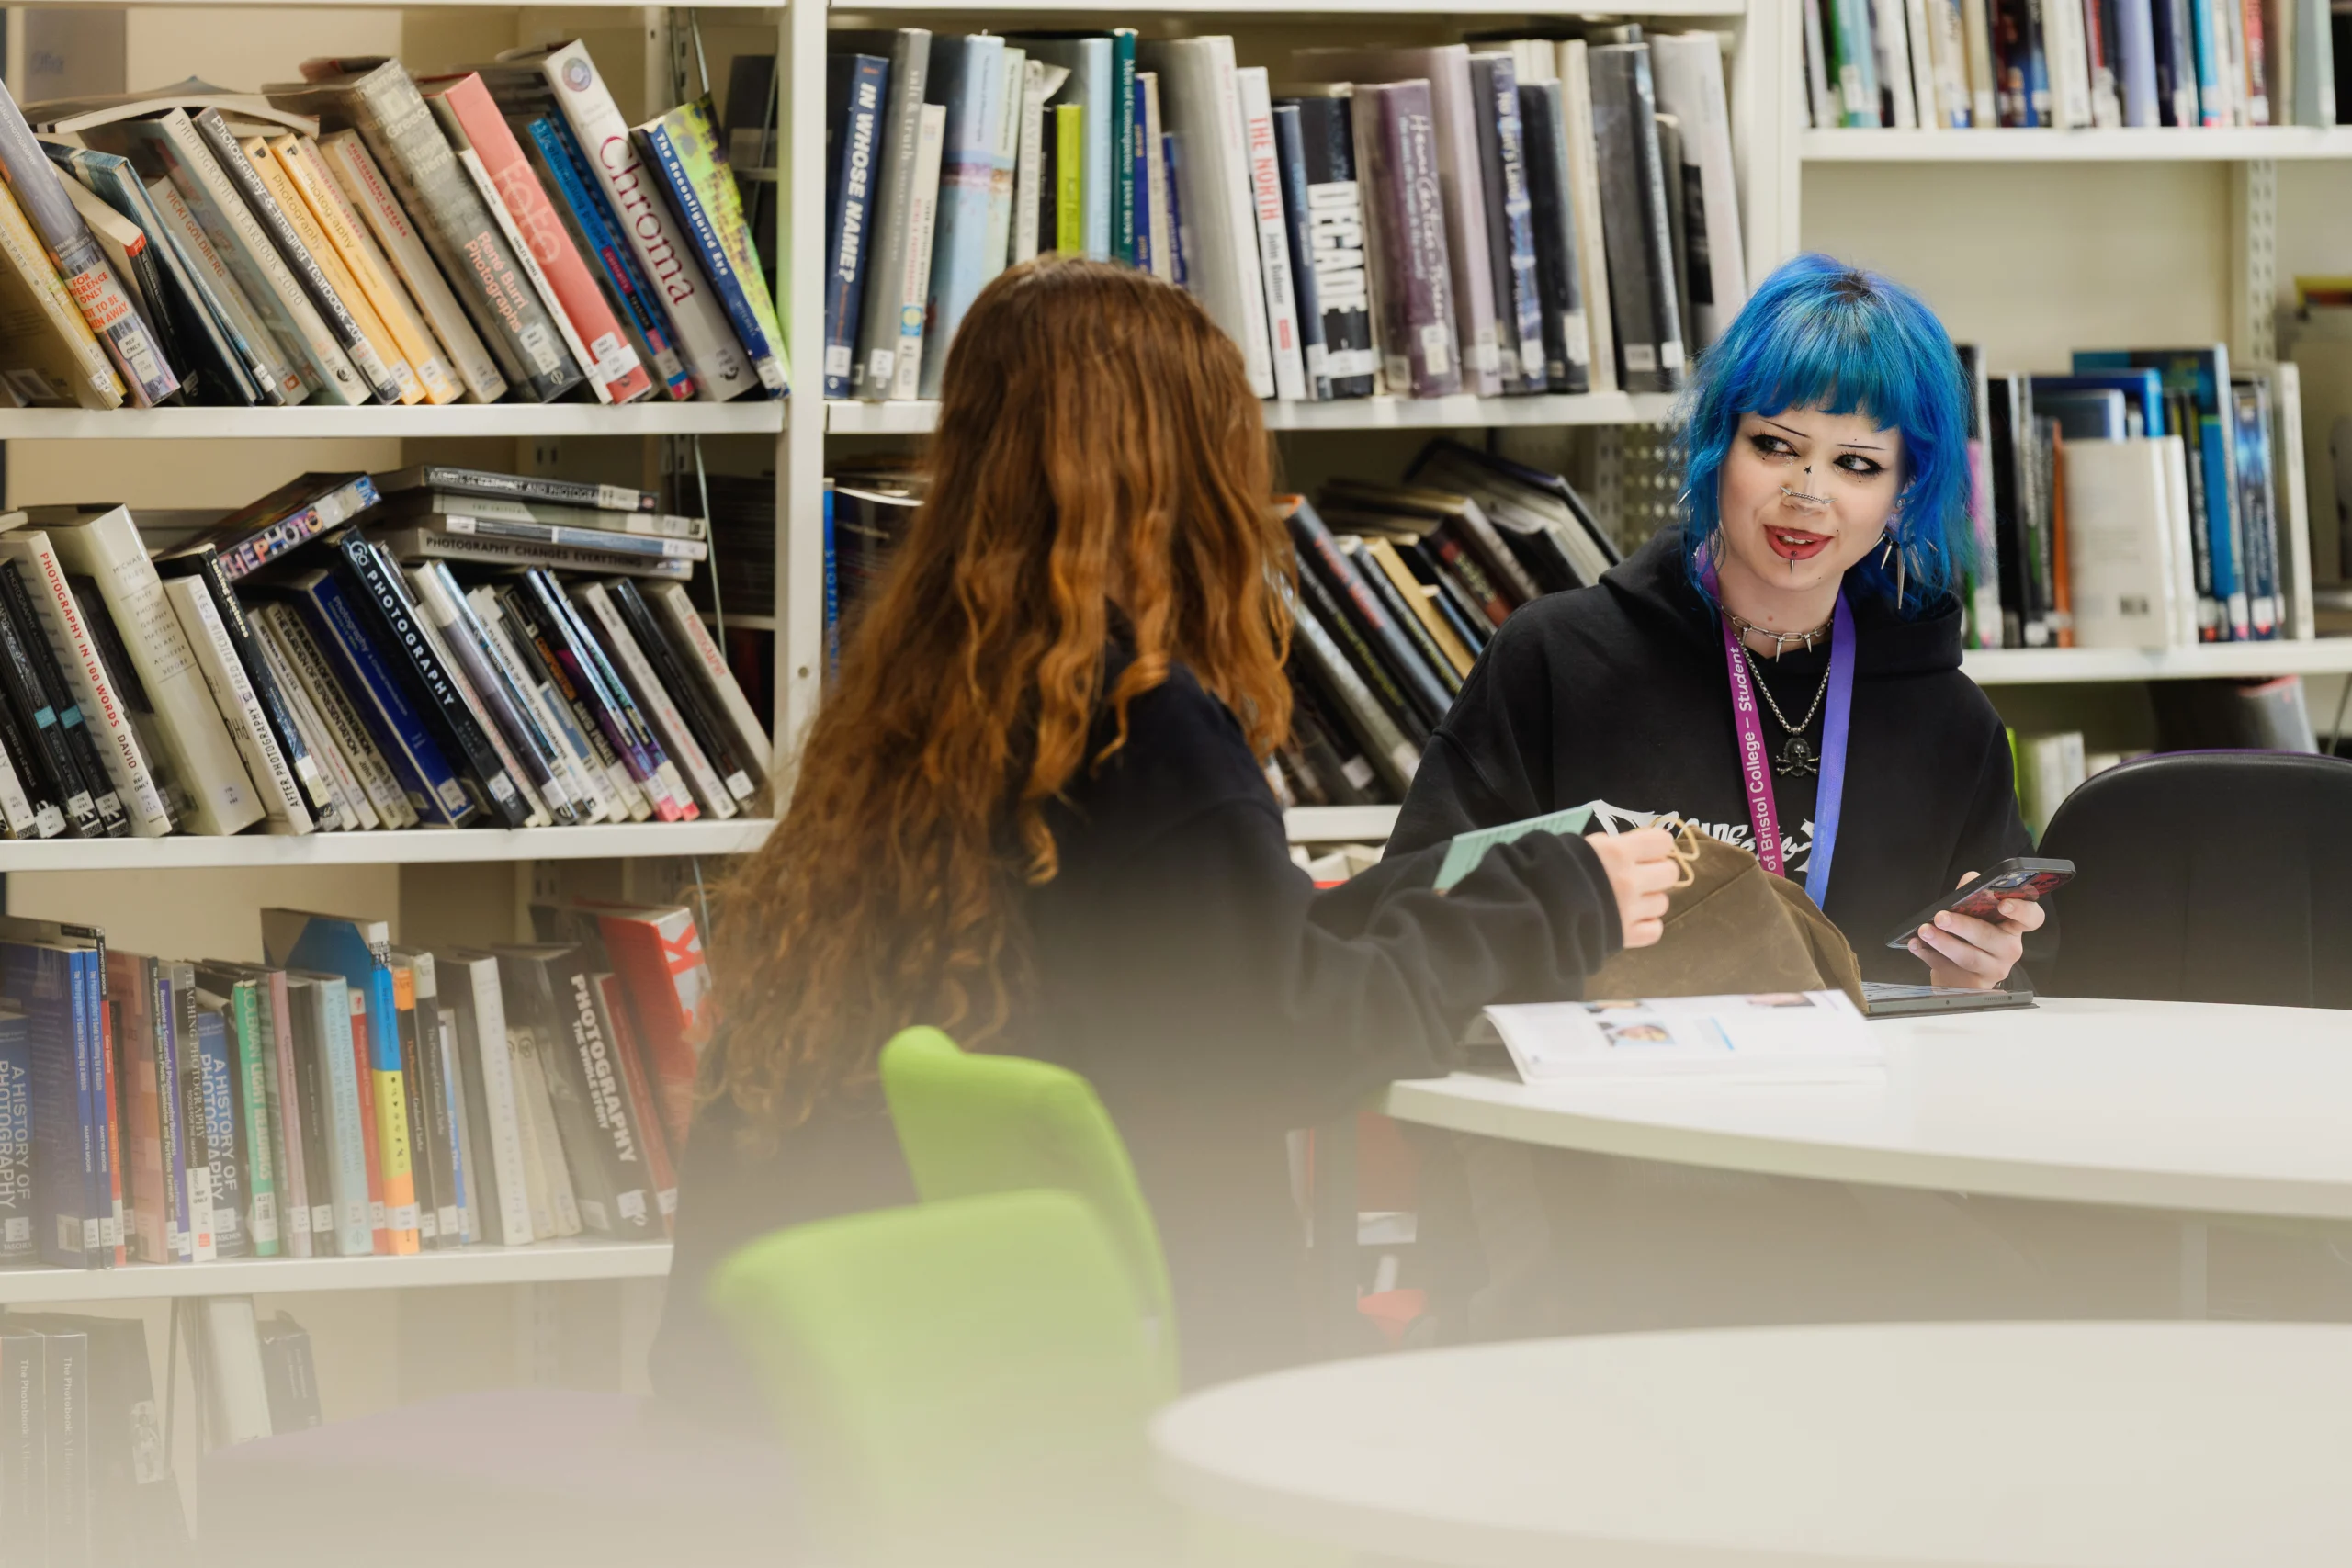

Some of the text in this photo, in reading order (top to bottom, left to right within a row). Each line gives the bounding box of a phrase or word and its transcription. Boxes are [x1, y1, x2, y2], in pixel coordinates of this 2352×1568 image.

[906, 101, 919, 113] &
[1023, 102, 1040, 164] DAVID
[1247, 114, 1271, 152] THE
[5, 118, 38, 166] PHOTOGRAPHY
[207, 114, 268, 197] Photography
[899, 118, 918, 160] truth
[263, 195, 277, 209] &
[303, 147, 342, 205] PHOTOGRAPHY
[346, 142, 388, 202] PHOTOGRAPHY
[384, 204, 408, 237] SPEAKS
[836, 82, 876, 283] IN WHOSE NAME?
[1251, 156, 1283, 221] NORTH
[175, 118, 237, 207] PHOTOGRAPHY
[234, 208, 280, 271] YEARBOOK
[276, 271, 305, 307] 2000
[269, 173, 325, 252] Photography
[599, 135, 696, 306] Chroma
[654, 132, 730, 276] The Reconfigured Eye
[164, 189, 188, 220] VICKI
[182, 219, 227, 279] GOLDBERG
[268, 208, 312, 264] Imaging
[1265, 231, 1283, 262] John
[1308, 178, 1367, 315] DECADE
[70, 271, 108, 296] FERENCE
[72, 273, 90, 287] FOR
[79, 287, 103, 304] ONLY
[304, 258, 351, 321] Yearbook
[461, 238, 525, 335] Photographs
[475, 230, 506, 273] René
[498, 269, 529, 310] Burri
[90, 301, 129, 329] KEN AWAY
[96, 300, 107, 313] TO
[107, 294, 119, 304] BE
[125, 337, 136, 346] REF
[126, 343, 141, 355] ONLY
[345, 320, 368, 346] 200
[112, 553, 147, 574] MCHAE
[425, 535, 643, 571] PHOTOGRAPHY CHANGES EVERYTHING
[5, 568, 38, 630] PHOTOGRAPHY
[135, 591, 153, 604] WHY
[135, 599, 164, 617] PHOTO-
[141, 611, 168, 629] GRAPHY
[208, 558, 253, 638] talking pictures
[143, 622, 175, 641] MATTERS
[364, 567, 456, 707] PHOTOGRAPHY
[40, 551, 137, 770] PHOTOGRAPHY IN 100 WORDS DAVID
[162, 657, 188, 676] BEFORE
[228, 664, 247, 691] FRED
[272, 609, 361, 756] THE BURDEN OF REPRESENTATION
[284, 609, 300, 629] THE
[294, 626, 323, 667] BURDEN
[322, 678, 374, 755] REPRESENTATION
[1730, 647, 1752, 712] Student
[245, 705, 286, 778] PHOTOGRAPHY
[1745, 731, 1764, 794] College
[133, 775, 144, 785] REF
[134, 783, 150, 792] ONLY
[277, 777, 300, 808] AFTER
[1752, 797, 1774, 852] Bristol
[1766, 855, 1777, 872] of
[97, 942, 107, 995] AMPHOTO BOOKS
[183, 970, 206, 1139] TEACHING PHOTOGRAPHY
[425, 1027, 435, 1042] The
[157, 989, 177, 1156] Running Successful Photography Business
[158, 1061, 166, 1081] Photo
[242, 987, 272, 1180] COLEMAN LIGHT READINGS
[334, 993, 362, 1172] ONE HUNDRED PHOTOGRAPHS
[425, 1042, 441, 1081] Photograph
[570, 974, 638, 1164] PHOTOGRAPHY
[570, 1019, 611, 1131] THE WHOLE STORY
[158, 1083, 169, 1125] Submission
[185, 1089, 193, 1111] TOOLS
[212, 1057, 238, 1191] A HISTORY OF
[0, 1060, 16, 1210] PHOTOGRAPHY
[9, 1065, 31, 1200] A HISTORY OF
[83, 1124, 93, 1173] MARTYN MOORE
[96, 1124, 107, 1173] MARTYN MOORE
[187, 1137, 198, 1168] IMAGING
[198, 1053, 224, 1201] PHOTOGRAPHY
[164, 1140, 173, 1173] Portfolio
[165, 1174, 175, 1202] Formats
[193, 1196, 208, 1204] ONLY
[3, 1241, 33, 1250] TASCHEN
[20, 1359, 29, 1438] The Photobook:
[63, 1357, 73, 1435] The Photobook:
